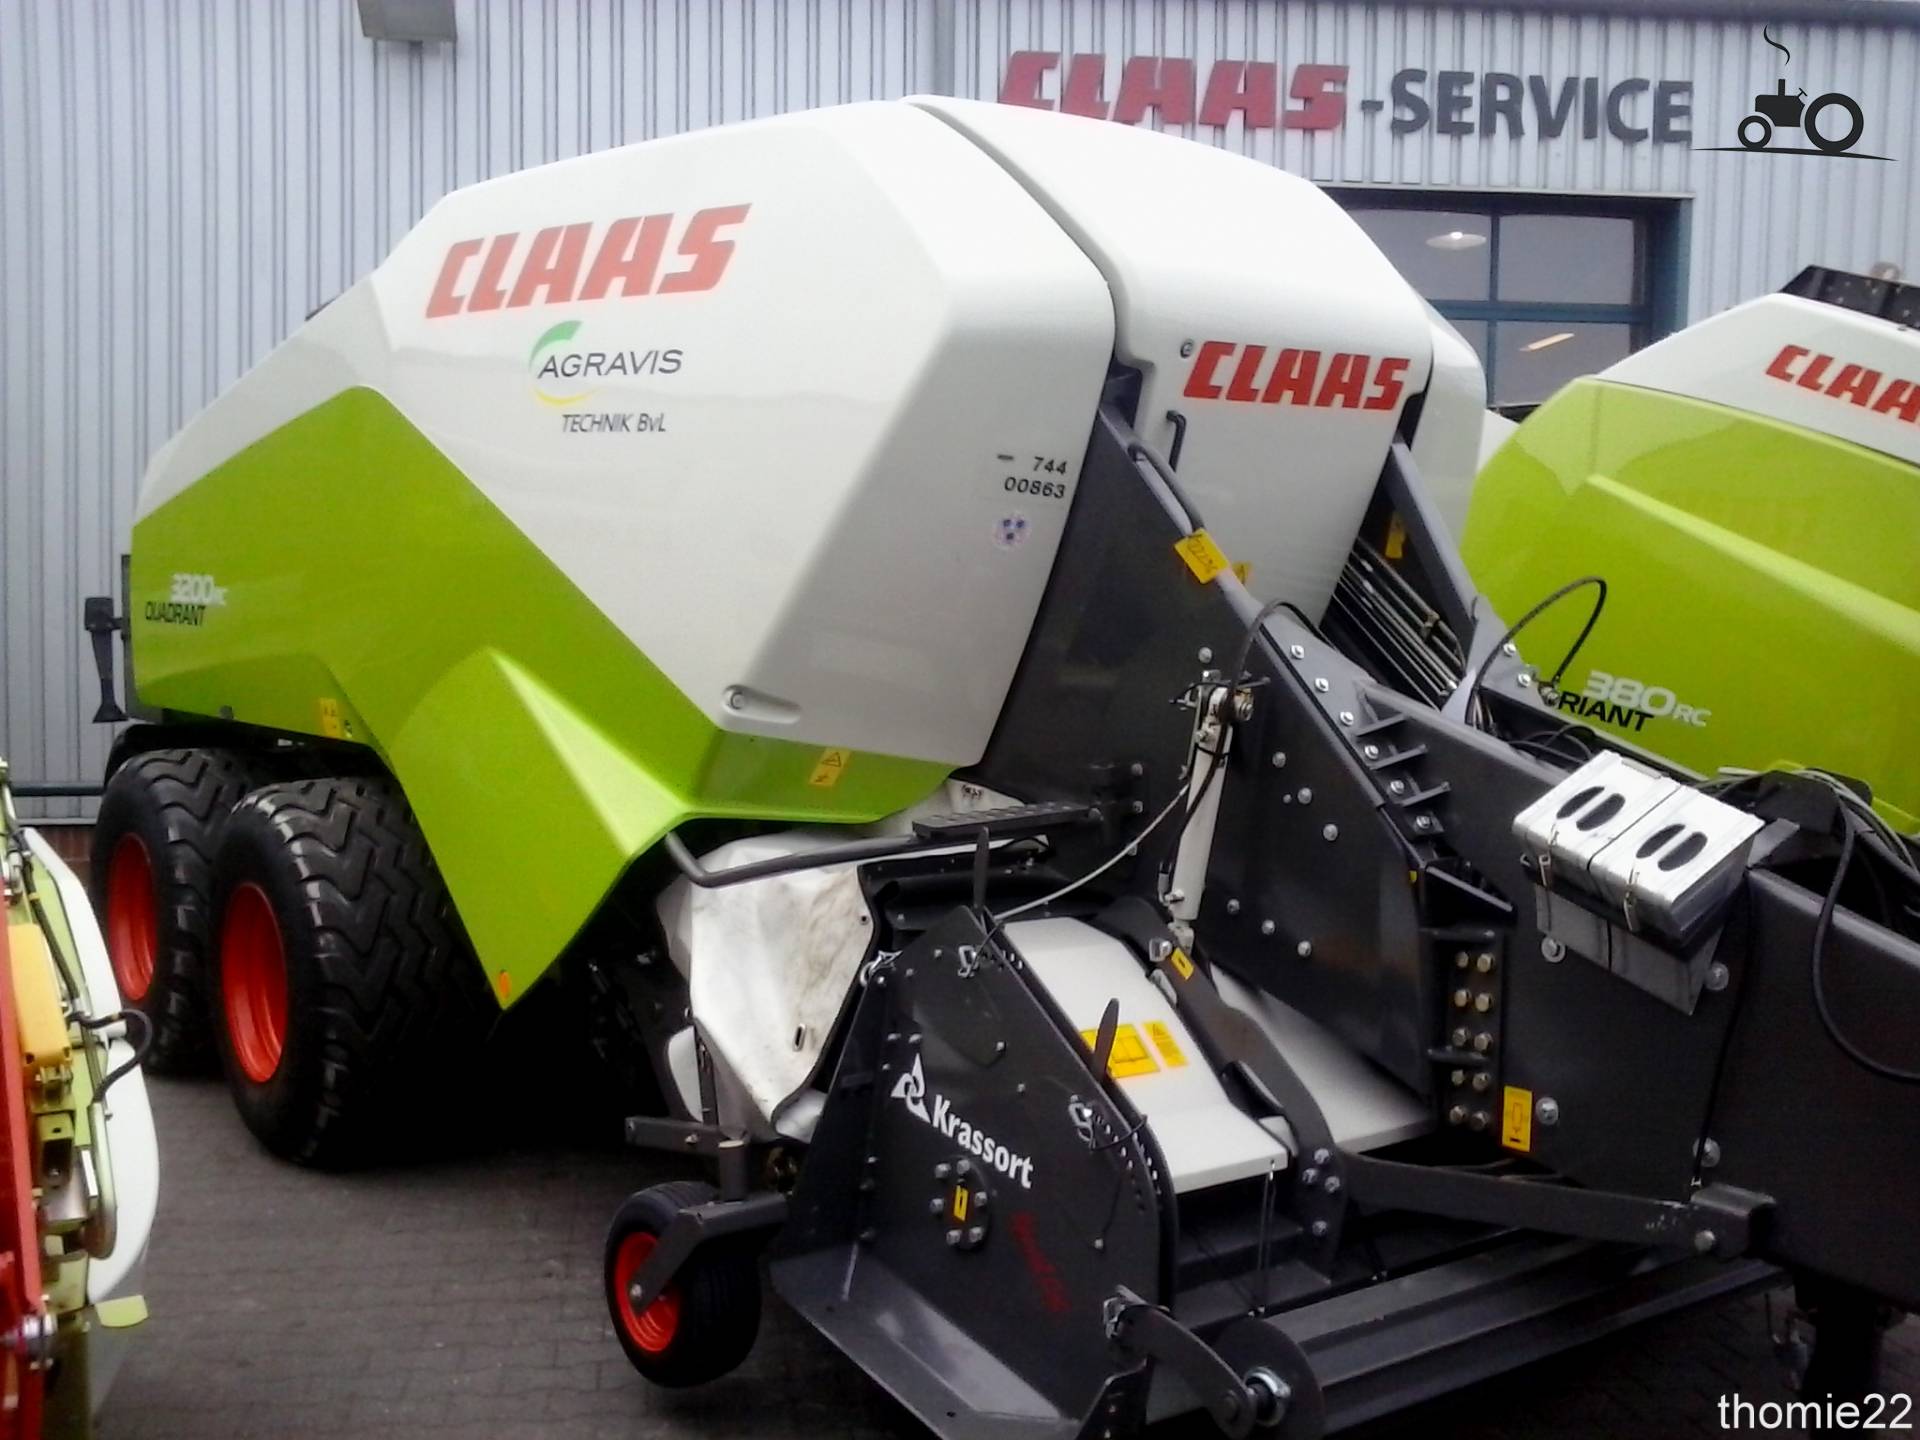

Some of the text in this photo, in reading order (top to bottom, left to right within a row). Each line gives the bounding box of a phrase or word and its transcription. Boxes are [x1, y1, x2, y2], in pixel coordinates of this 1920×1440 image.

[425, 203, 752, 319] CLAAS
[538, 349, 683, 379] AGRAVIS
[1183, 340, 1410, 411] CLAAS
[561, 412, 633, 433] TECHNIK
[1033, 455, 1067, 475] 744
[1004, 476, 1066, 499] 00863
[932, 1094, 1034, 1189] Krassort
